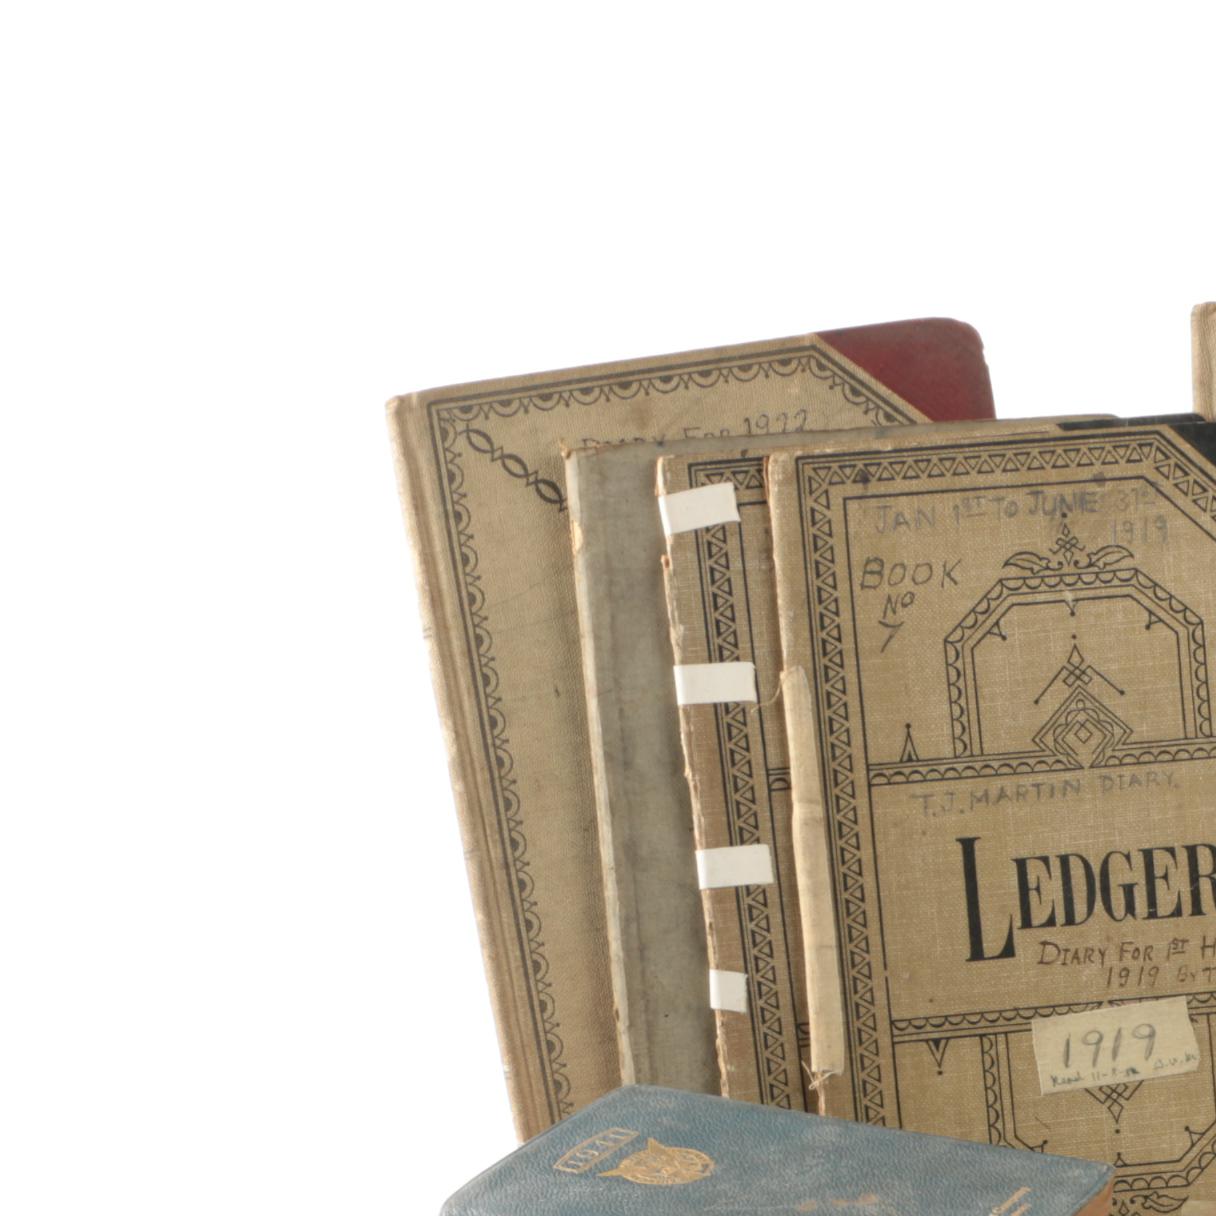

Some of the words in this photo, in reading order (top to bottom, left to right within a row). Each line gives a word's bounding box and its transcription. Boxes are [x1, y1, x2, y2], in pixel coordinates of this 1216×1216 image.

[875, 504, 937, 534] JAN
[861, 557, 962, 590] BOOK
[1037, 941, 1106, 967] DIARY
[1119, 941, 1153, 961] FOR
[1107, 965, 1159, 988] 1919
[1063, 1024, 1156, 1068] 1919
